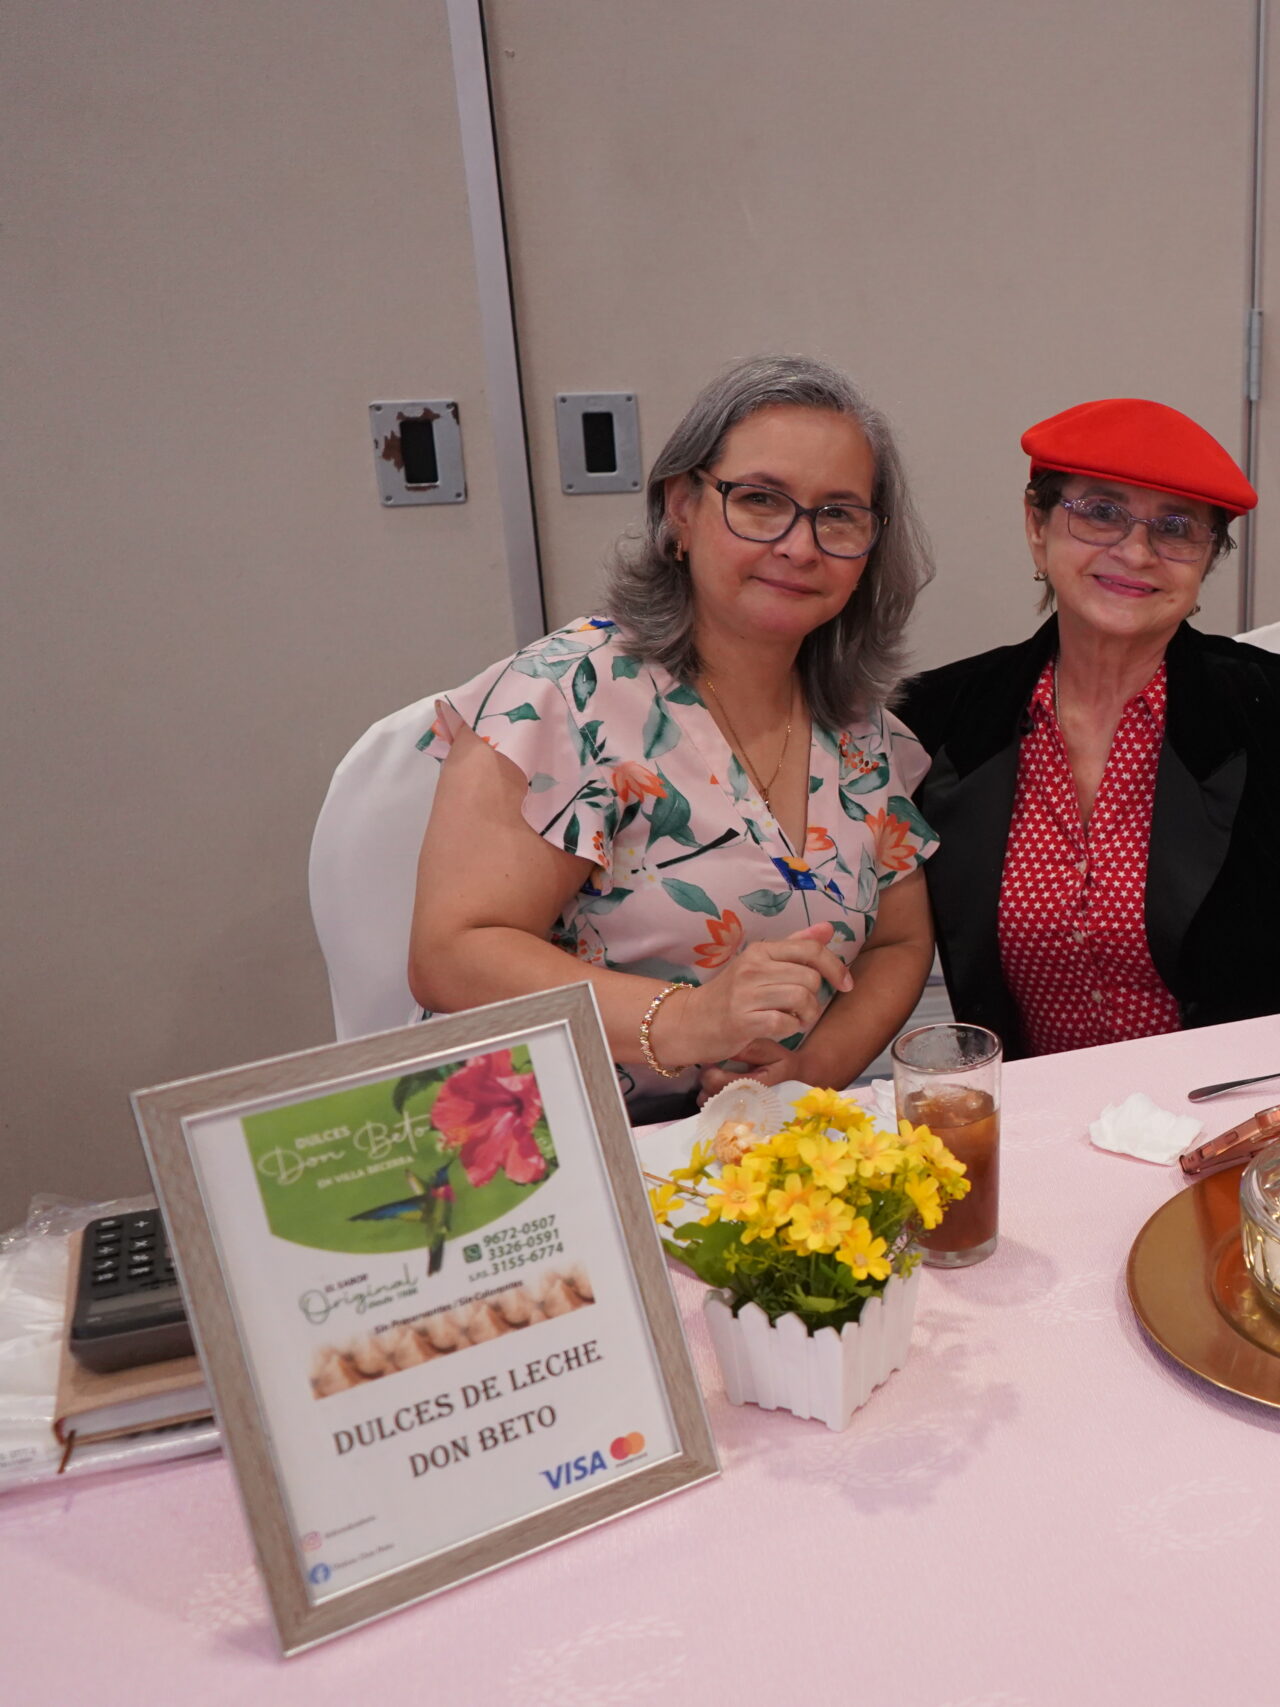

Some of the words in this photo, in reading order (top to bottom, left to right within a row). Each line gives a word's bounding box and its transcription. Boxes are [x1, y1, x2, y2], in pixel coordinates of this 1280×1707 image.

[257, 1146, 346, 1186] Don
[353, 1110, 431, 1160] Beto
[483, 1214, 556, 1247] 9672-0507
[489, 1228, 560, 1261] 3326-0591
[491, 1241, 564, 1276] 3155-6774
[298, 1262, 418, 1325] Original
[332, 1393, 455, 1455] DULCES
[460, 1376, 503, 1409] DE
[508, 1340, 604, 1392] LECHE
[408, 1436, 471, 1478] DON
[477, 1404, 557, 1452] BETO
[539, 1450, 608, 1490] VISA
